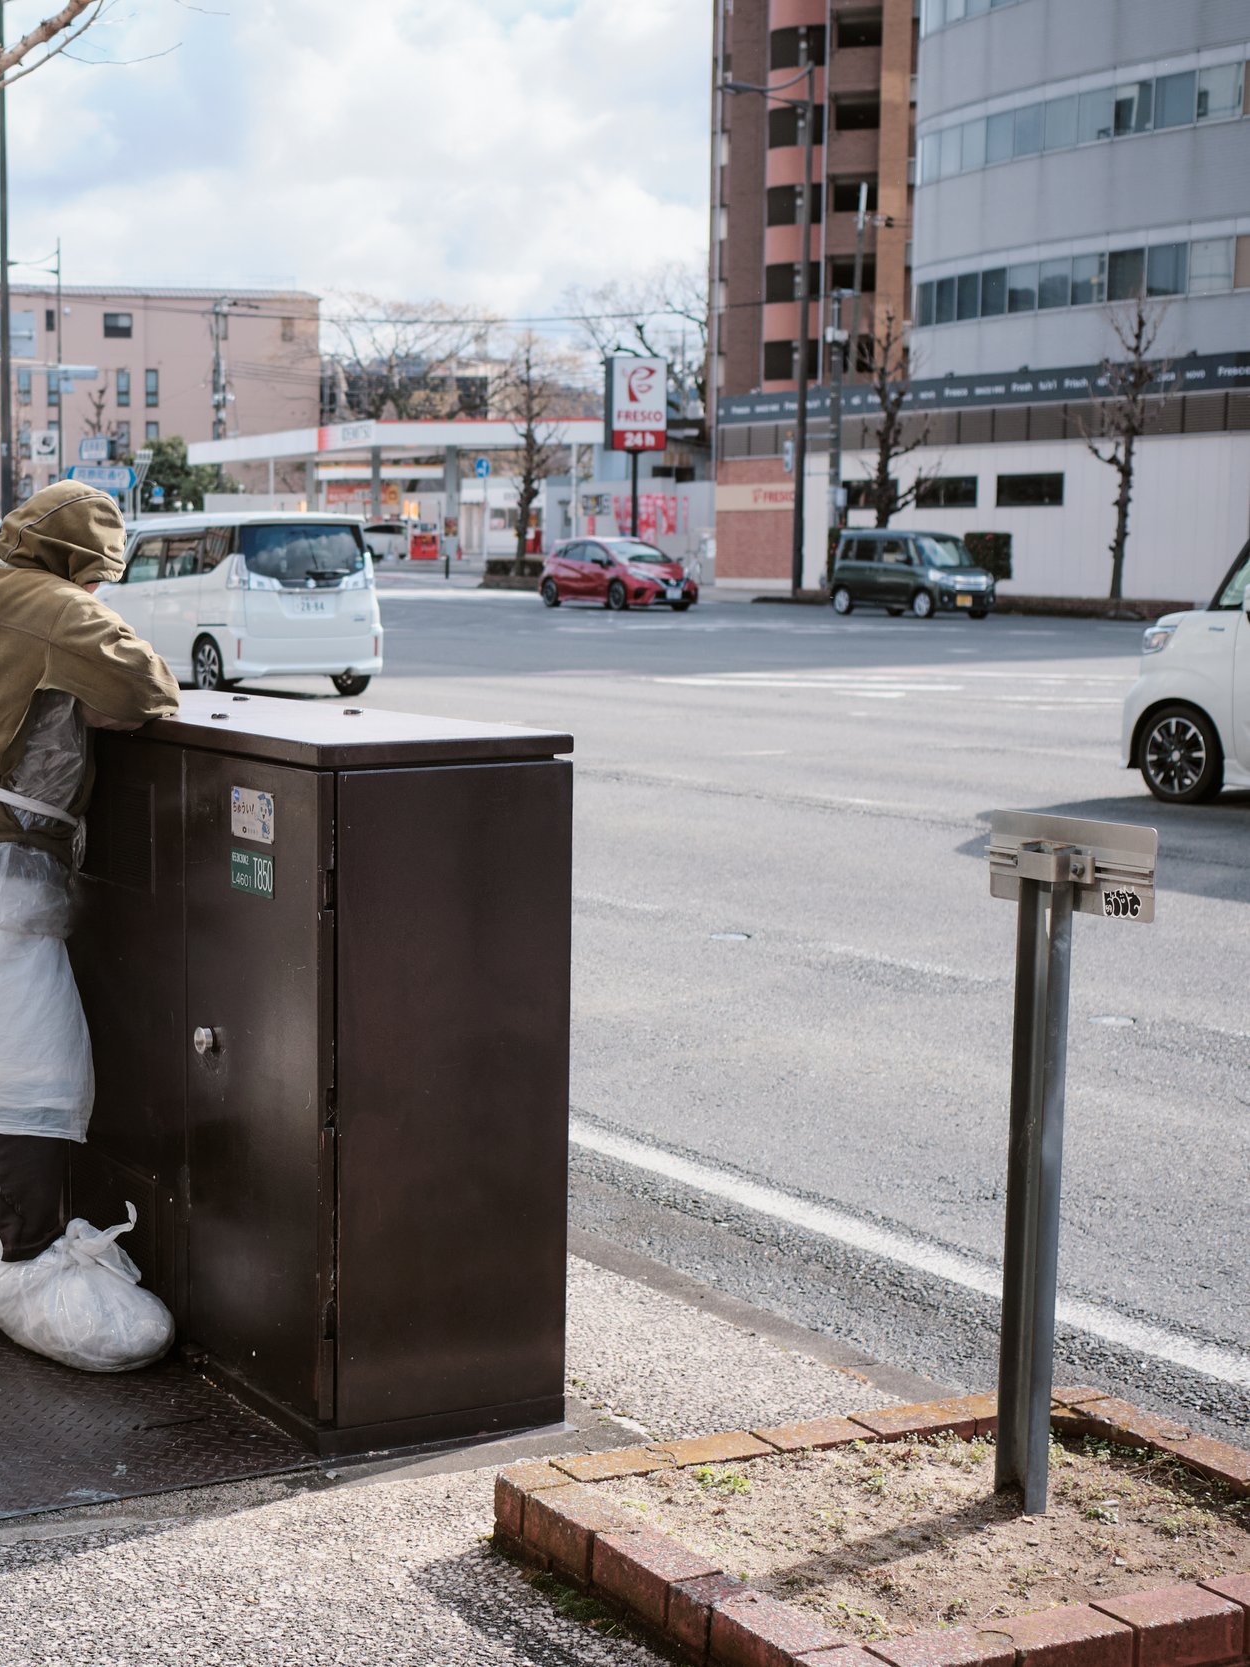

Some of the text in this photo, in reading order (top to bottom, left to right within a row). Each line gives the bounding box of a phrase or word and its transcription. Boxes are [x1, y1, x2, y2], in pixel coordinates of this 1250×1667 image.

[617, 411, 663, 422] FRESCO
[231, 871, 252, 888] L4601
[253, 857, 273, 893] T850
